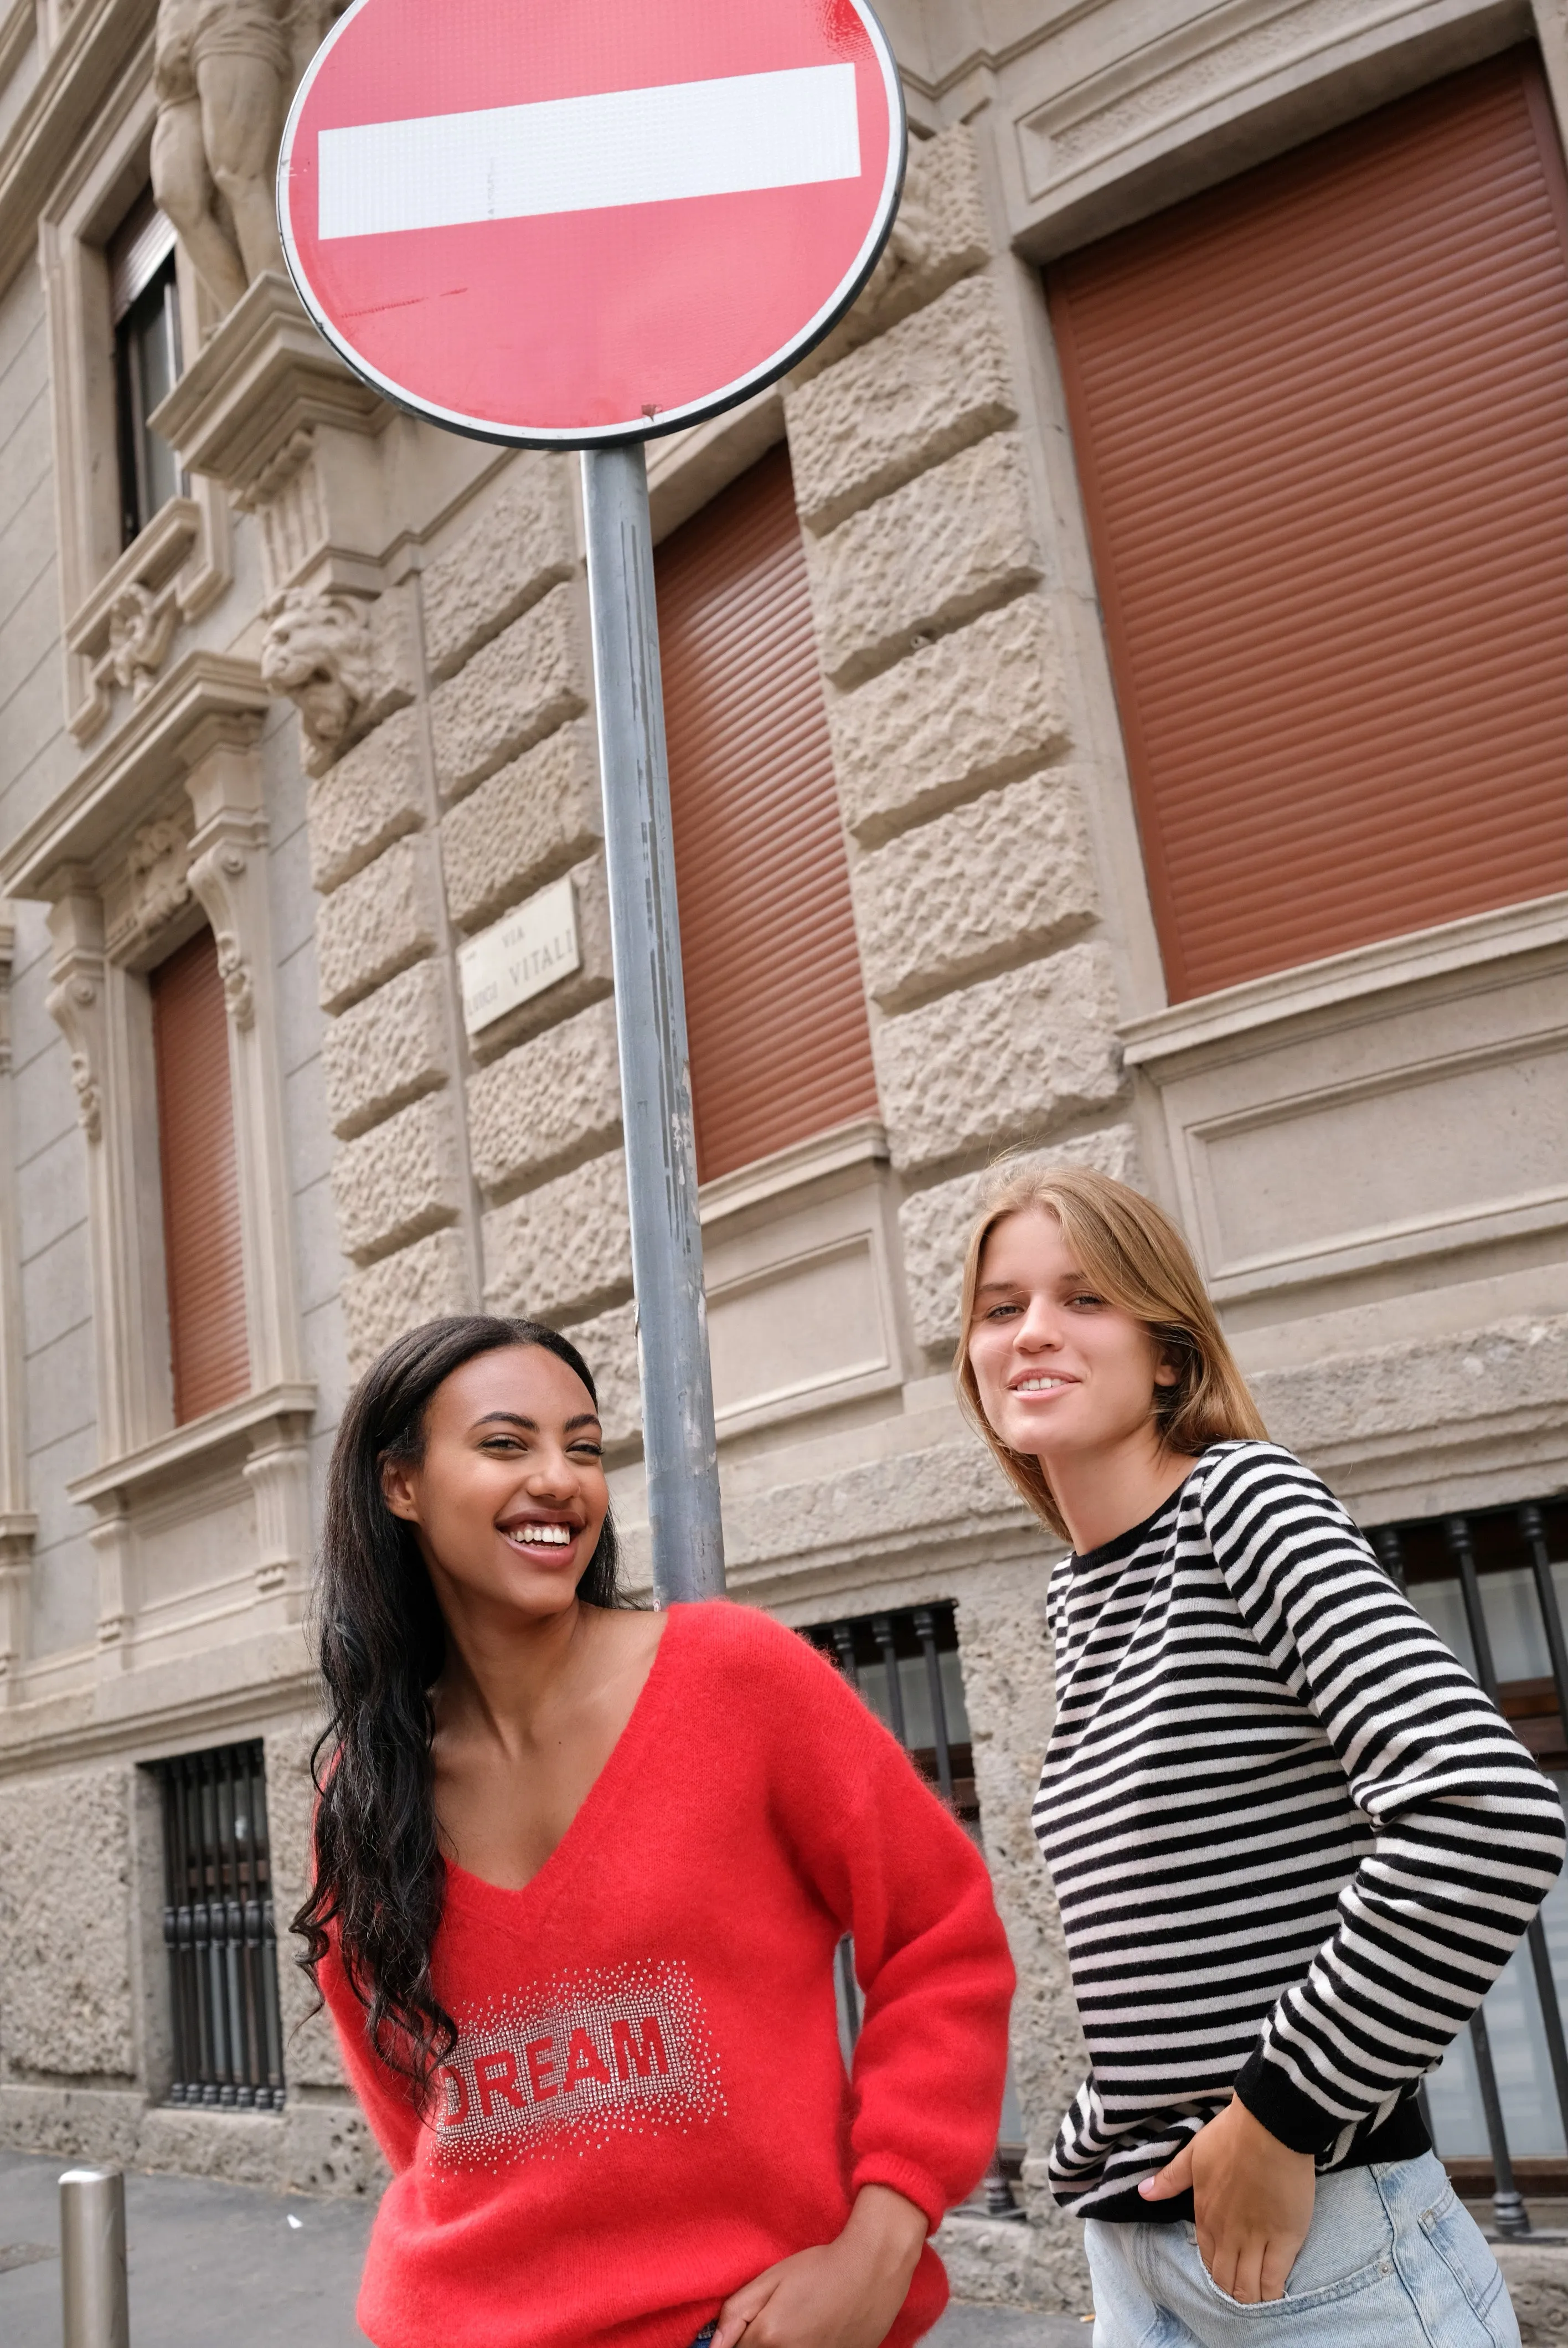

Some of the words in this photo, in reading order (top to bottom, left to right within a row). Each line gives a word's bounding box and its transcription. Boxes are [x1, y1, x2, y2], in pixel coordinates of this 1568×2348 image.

[502, 926, 525, 948] VIA
[509, 929, 574, 986] VITALI
[439, 2016, 669, 2125] DREAM
